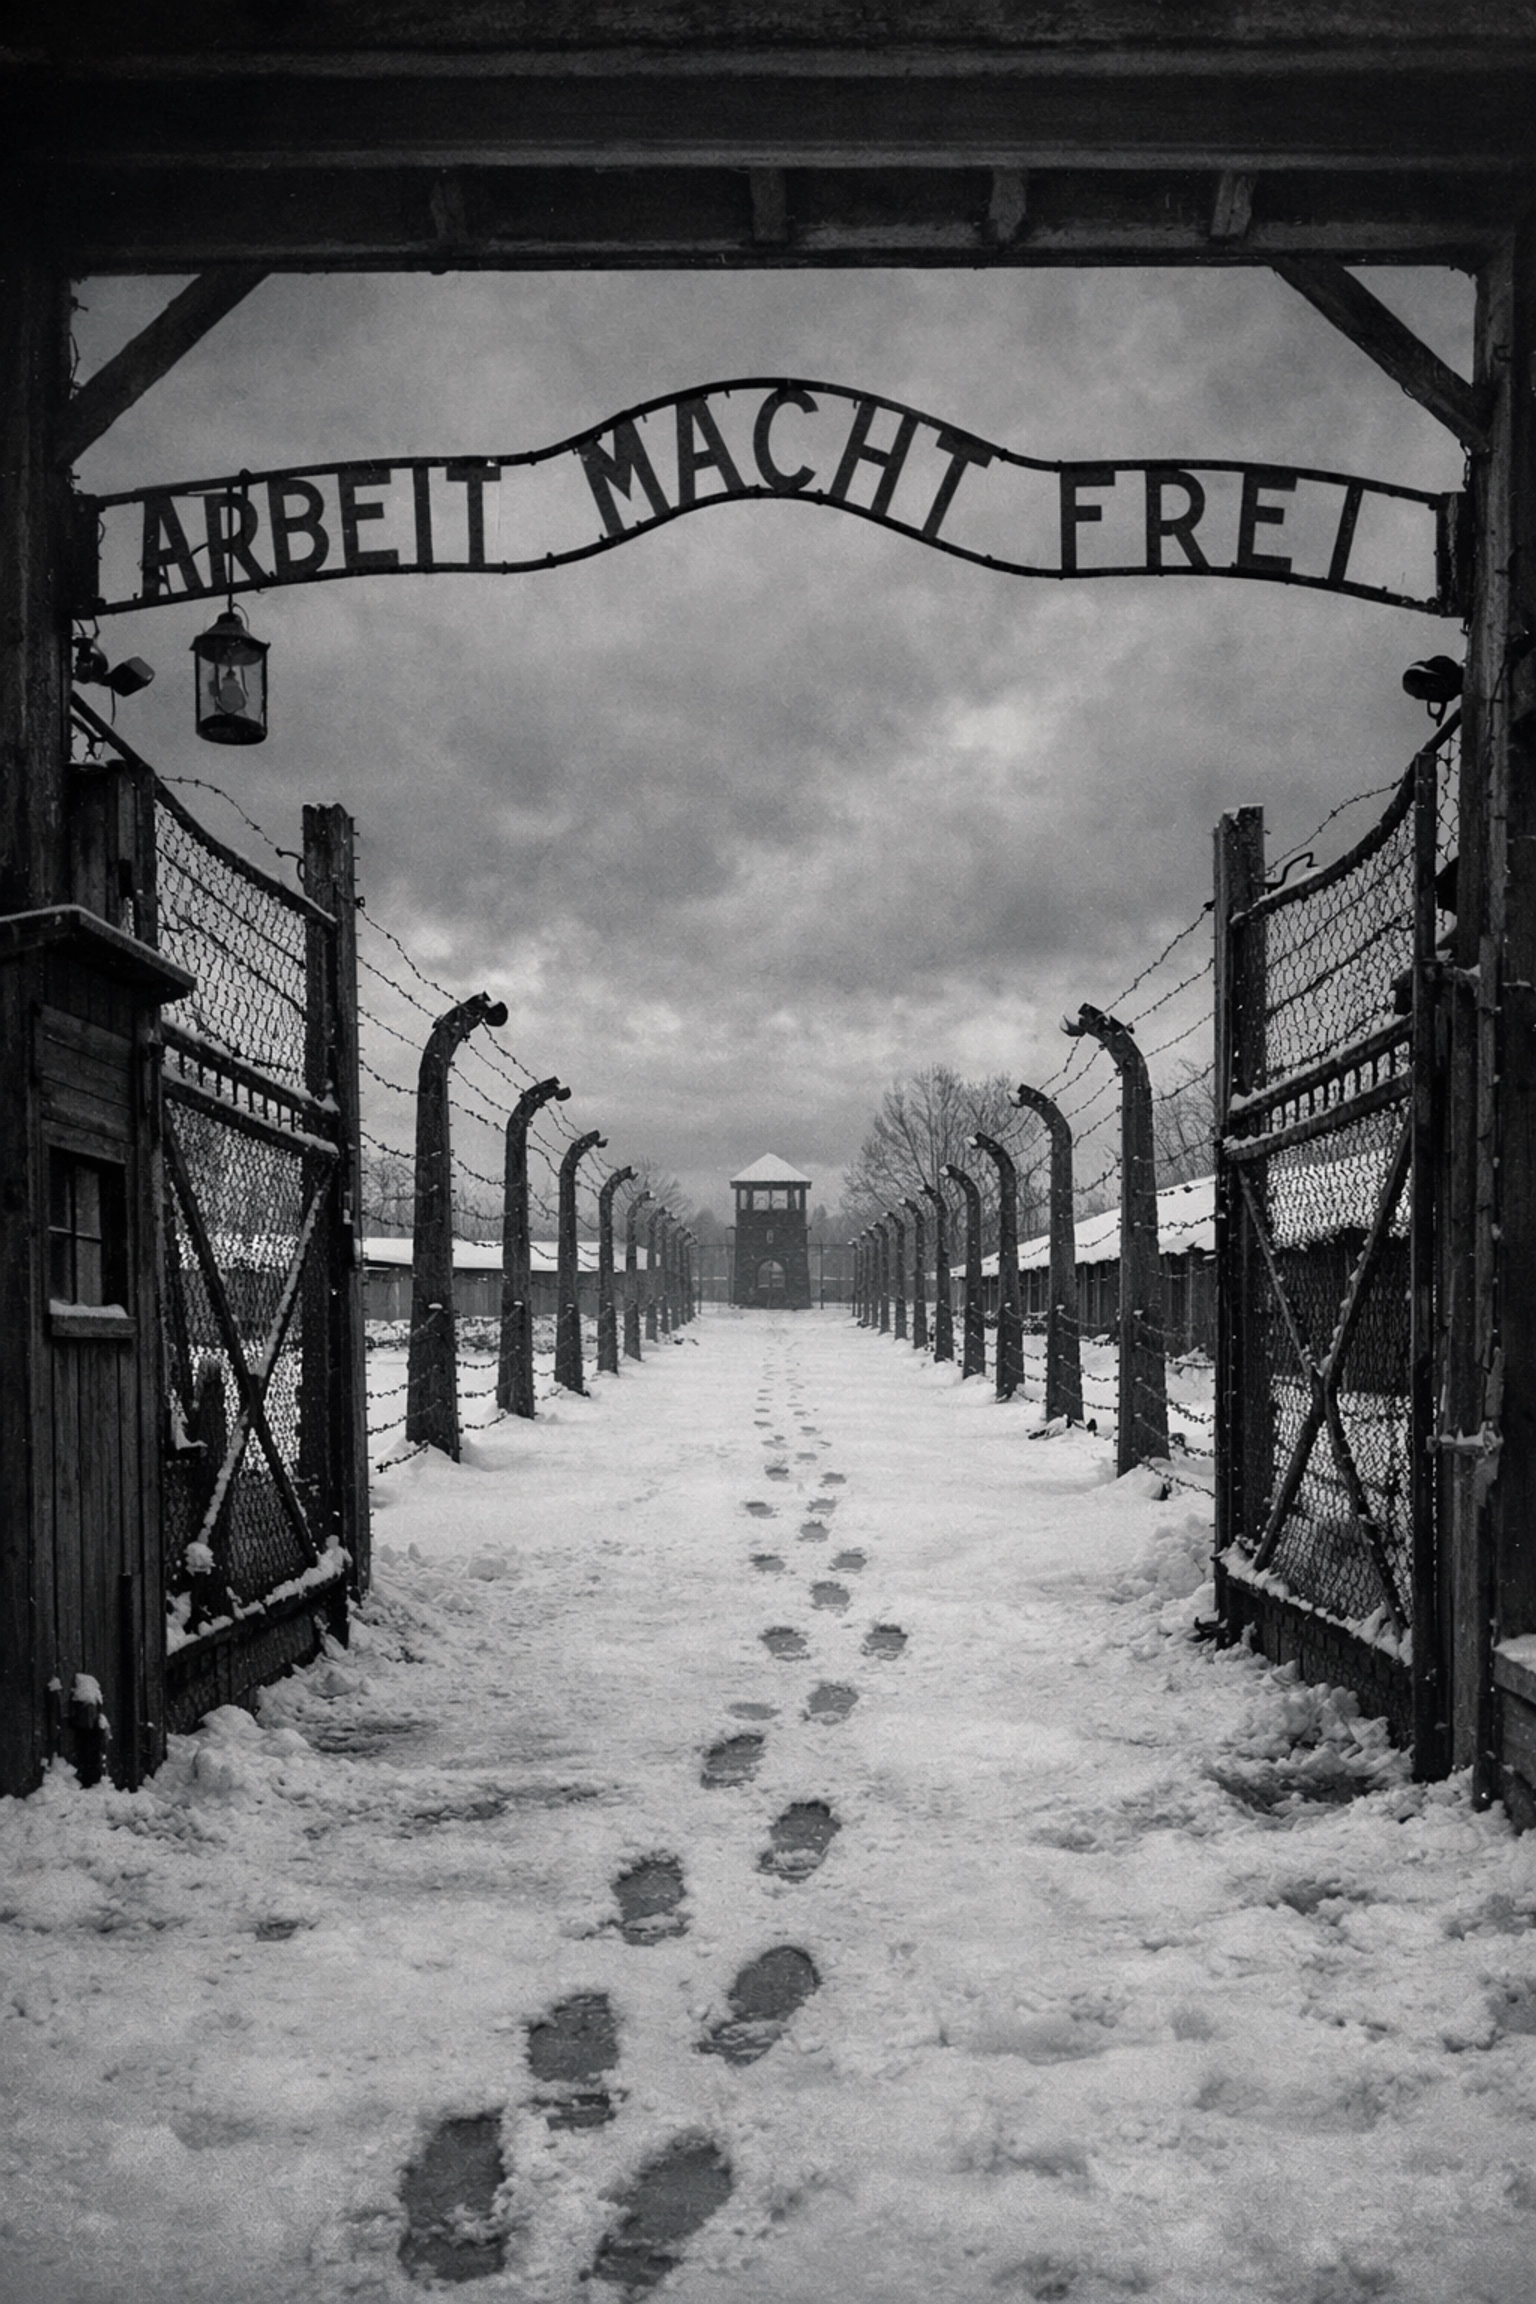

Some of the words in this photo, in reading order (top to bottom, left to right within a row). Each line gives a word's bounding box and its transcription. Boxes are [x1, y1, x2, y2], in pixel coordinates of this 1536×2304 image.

[141, 464, 502, 600] ARBEIT
[577, 386, 994, 538] MACHT
[1060, 466, 1364, 584] FREI
